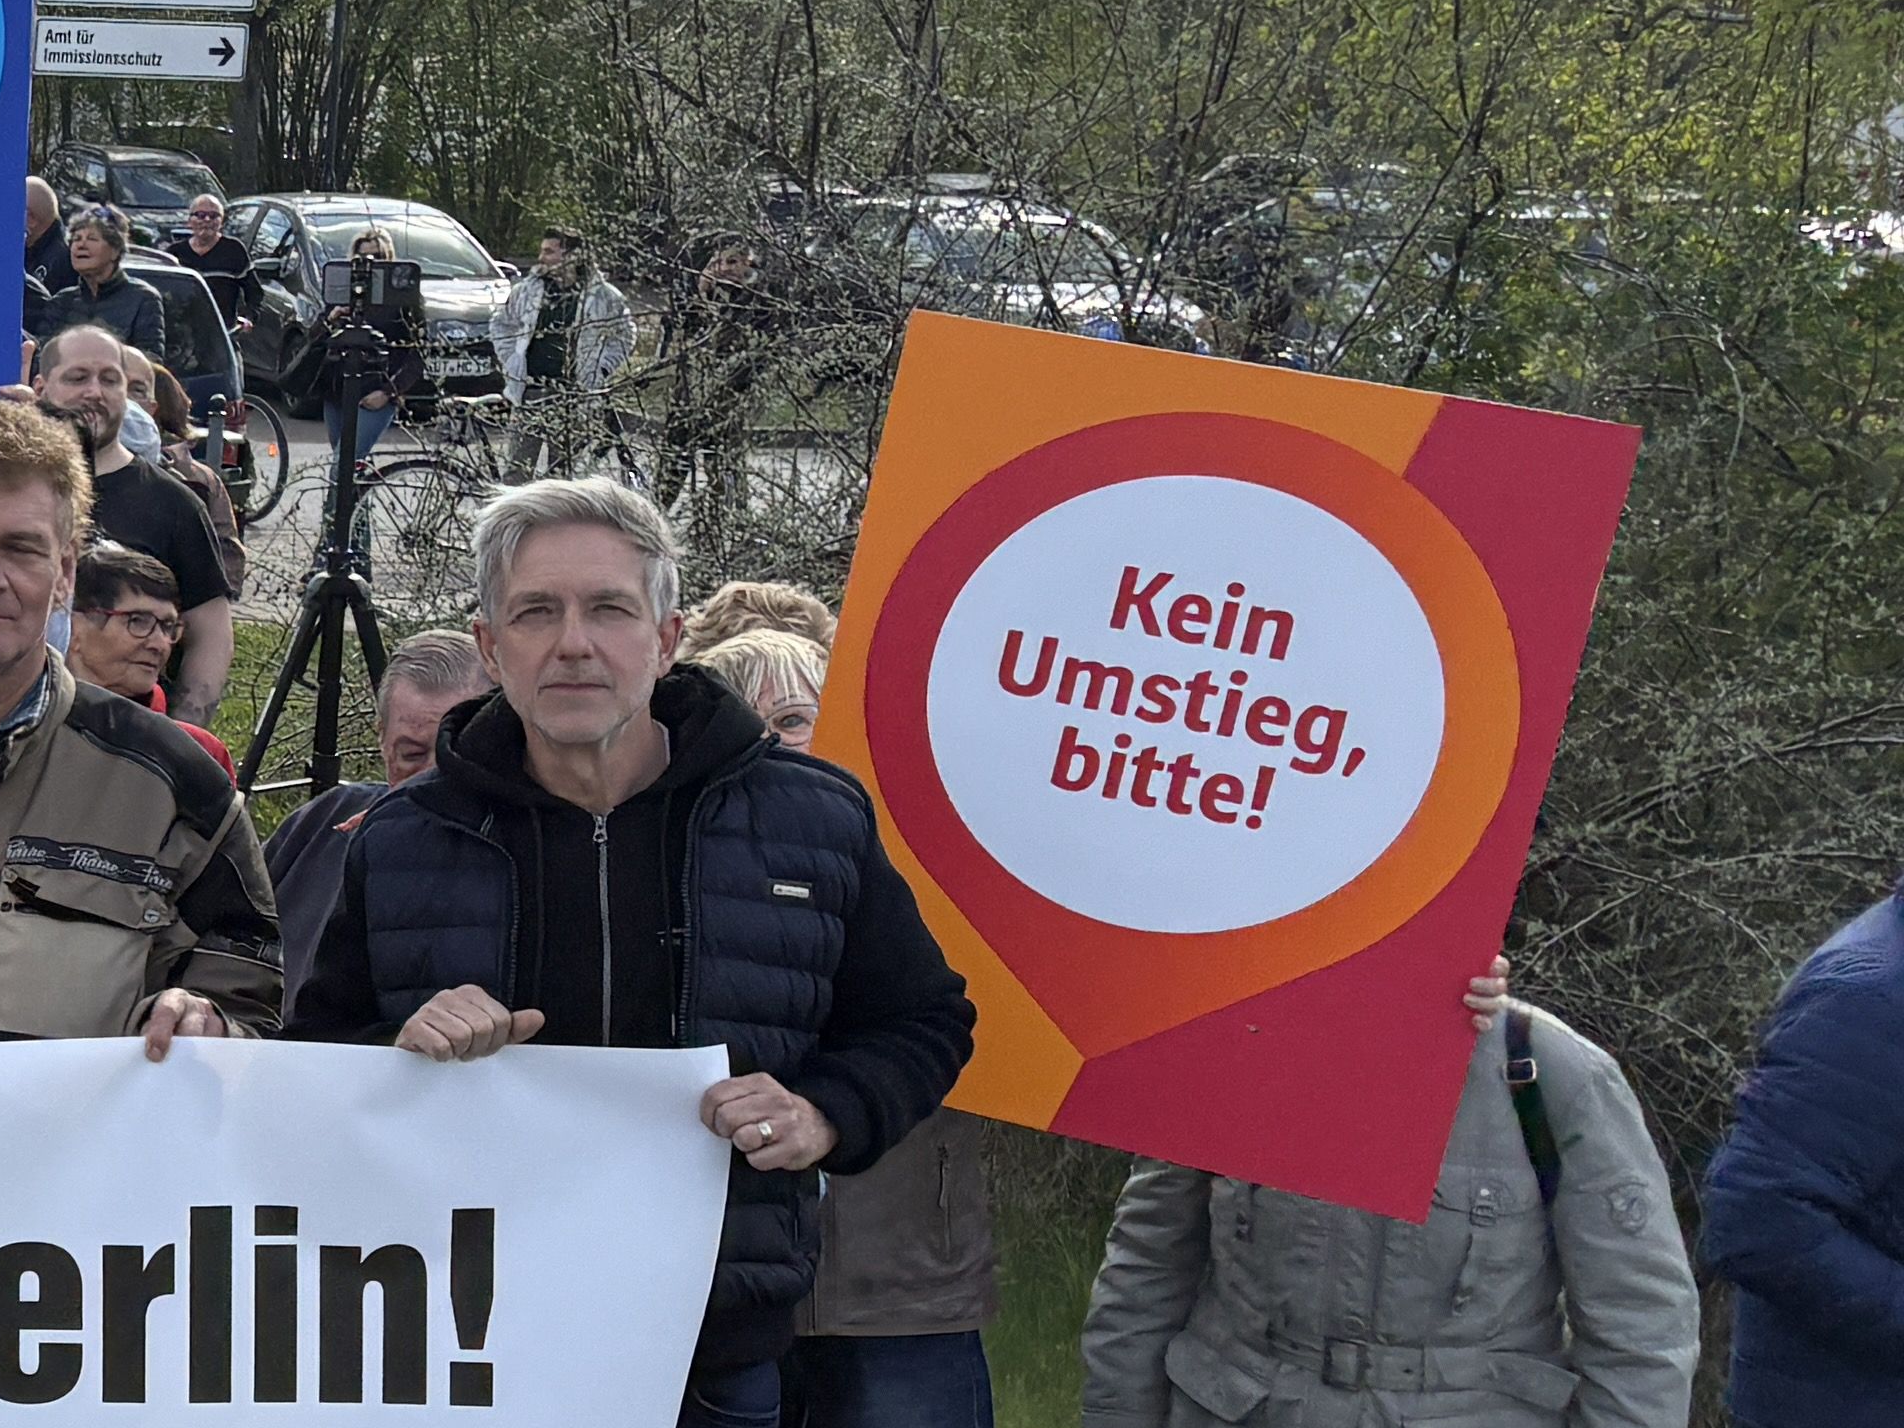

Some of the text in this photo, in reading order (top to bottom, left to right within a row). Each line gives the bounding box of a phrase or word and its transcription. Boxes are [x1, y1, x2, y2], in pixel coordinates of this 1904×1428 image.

[43, 47, 162, 66] Immissionsschutz
[45, 29, 94, 45] Amt für
[1110, 566, 1294, 661] Kein
[999, 630, 1365, 778] Umstieg,
[1051, 726, 1277, 830] bitte!
